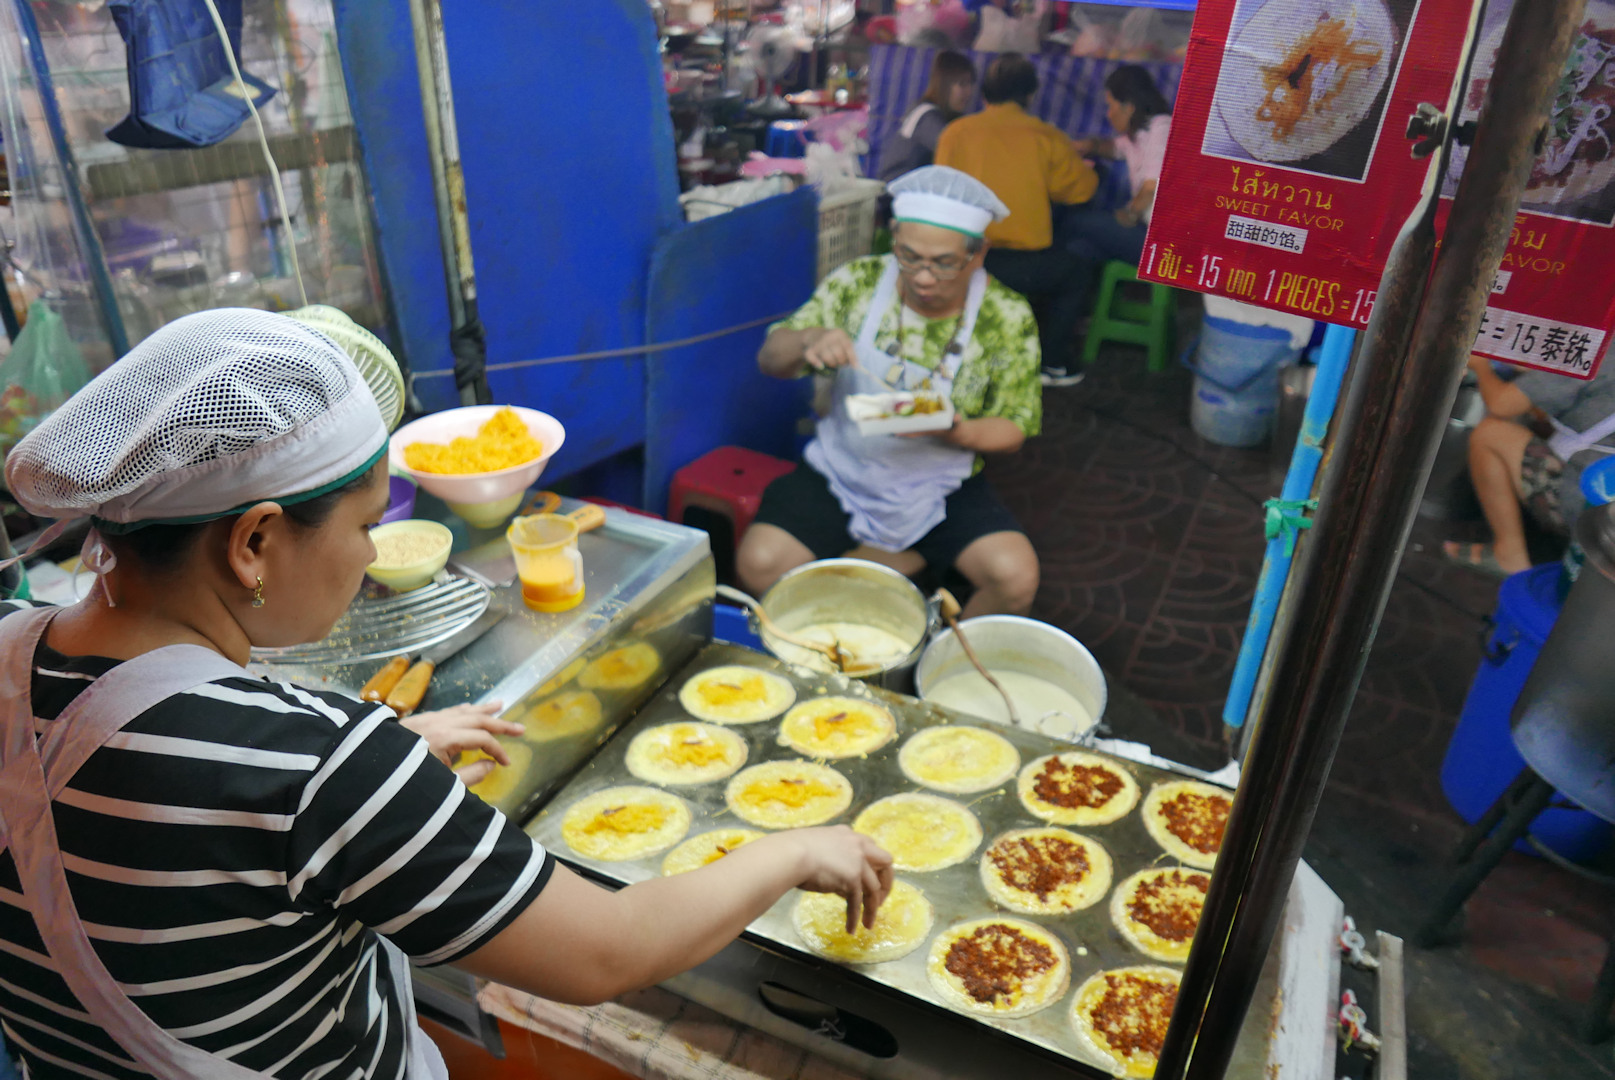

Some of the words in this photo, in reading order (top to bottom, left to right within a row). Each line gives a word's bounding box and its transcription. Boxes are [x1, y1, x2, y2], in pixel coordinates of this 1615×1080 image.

[1232, 165, 1333, 210] ไส้หวาน
[1215, 195, 1271, 217] SWEET
[1278, 207, 1344, 231] FAVOR
[1227, 220, 1300, 251] 甜甜的馅。
[1146, 243, 1157, 274] 1
[1198, 254, 1223, 289] 15
[1264, 269, 1276, 301] 1
[1275, 271, 1341, 316] PIECES
[1501, 252, 1566, 275] AVOR
